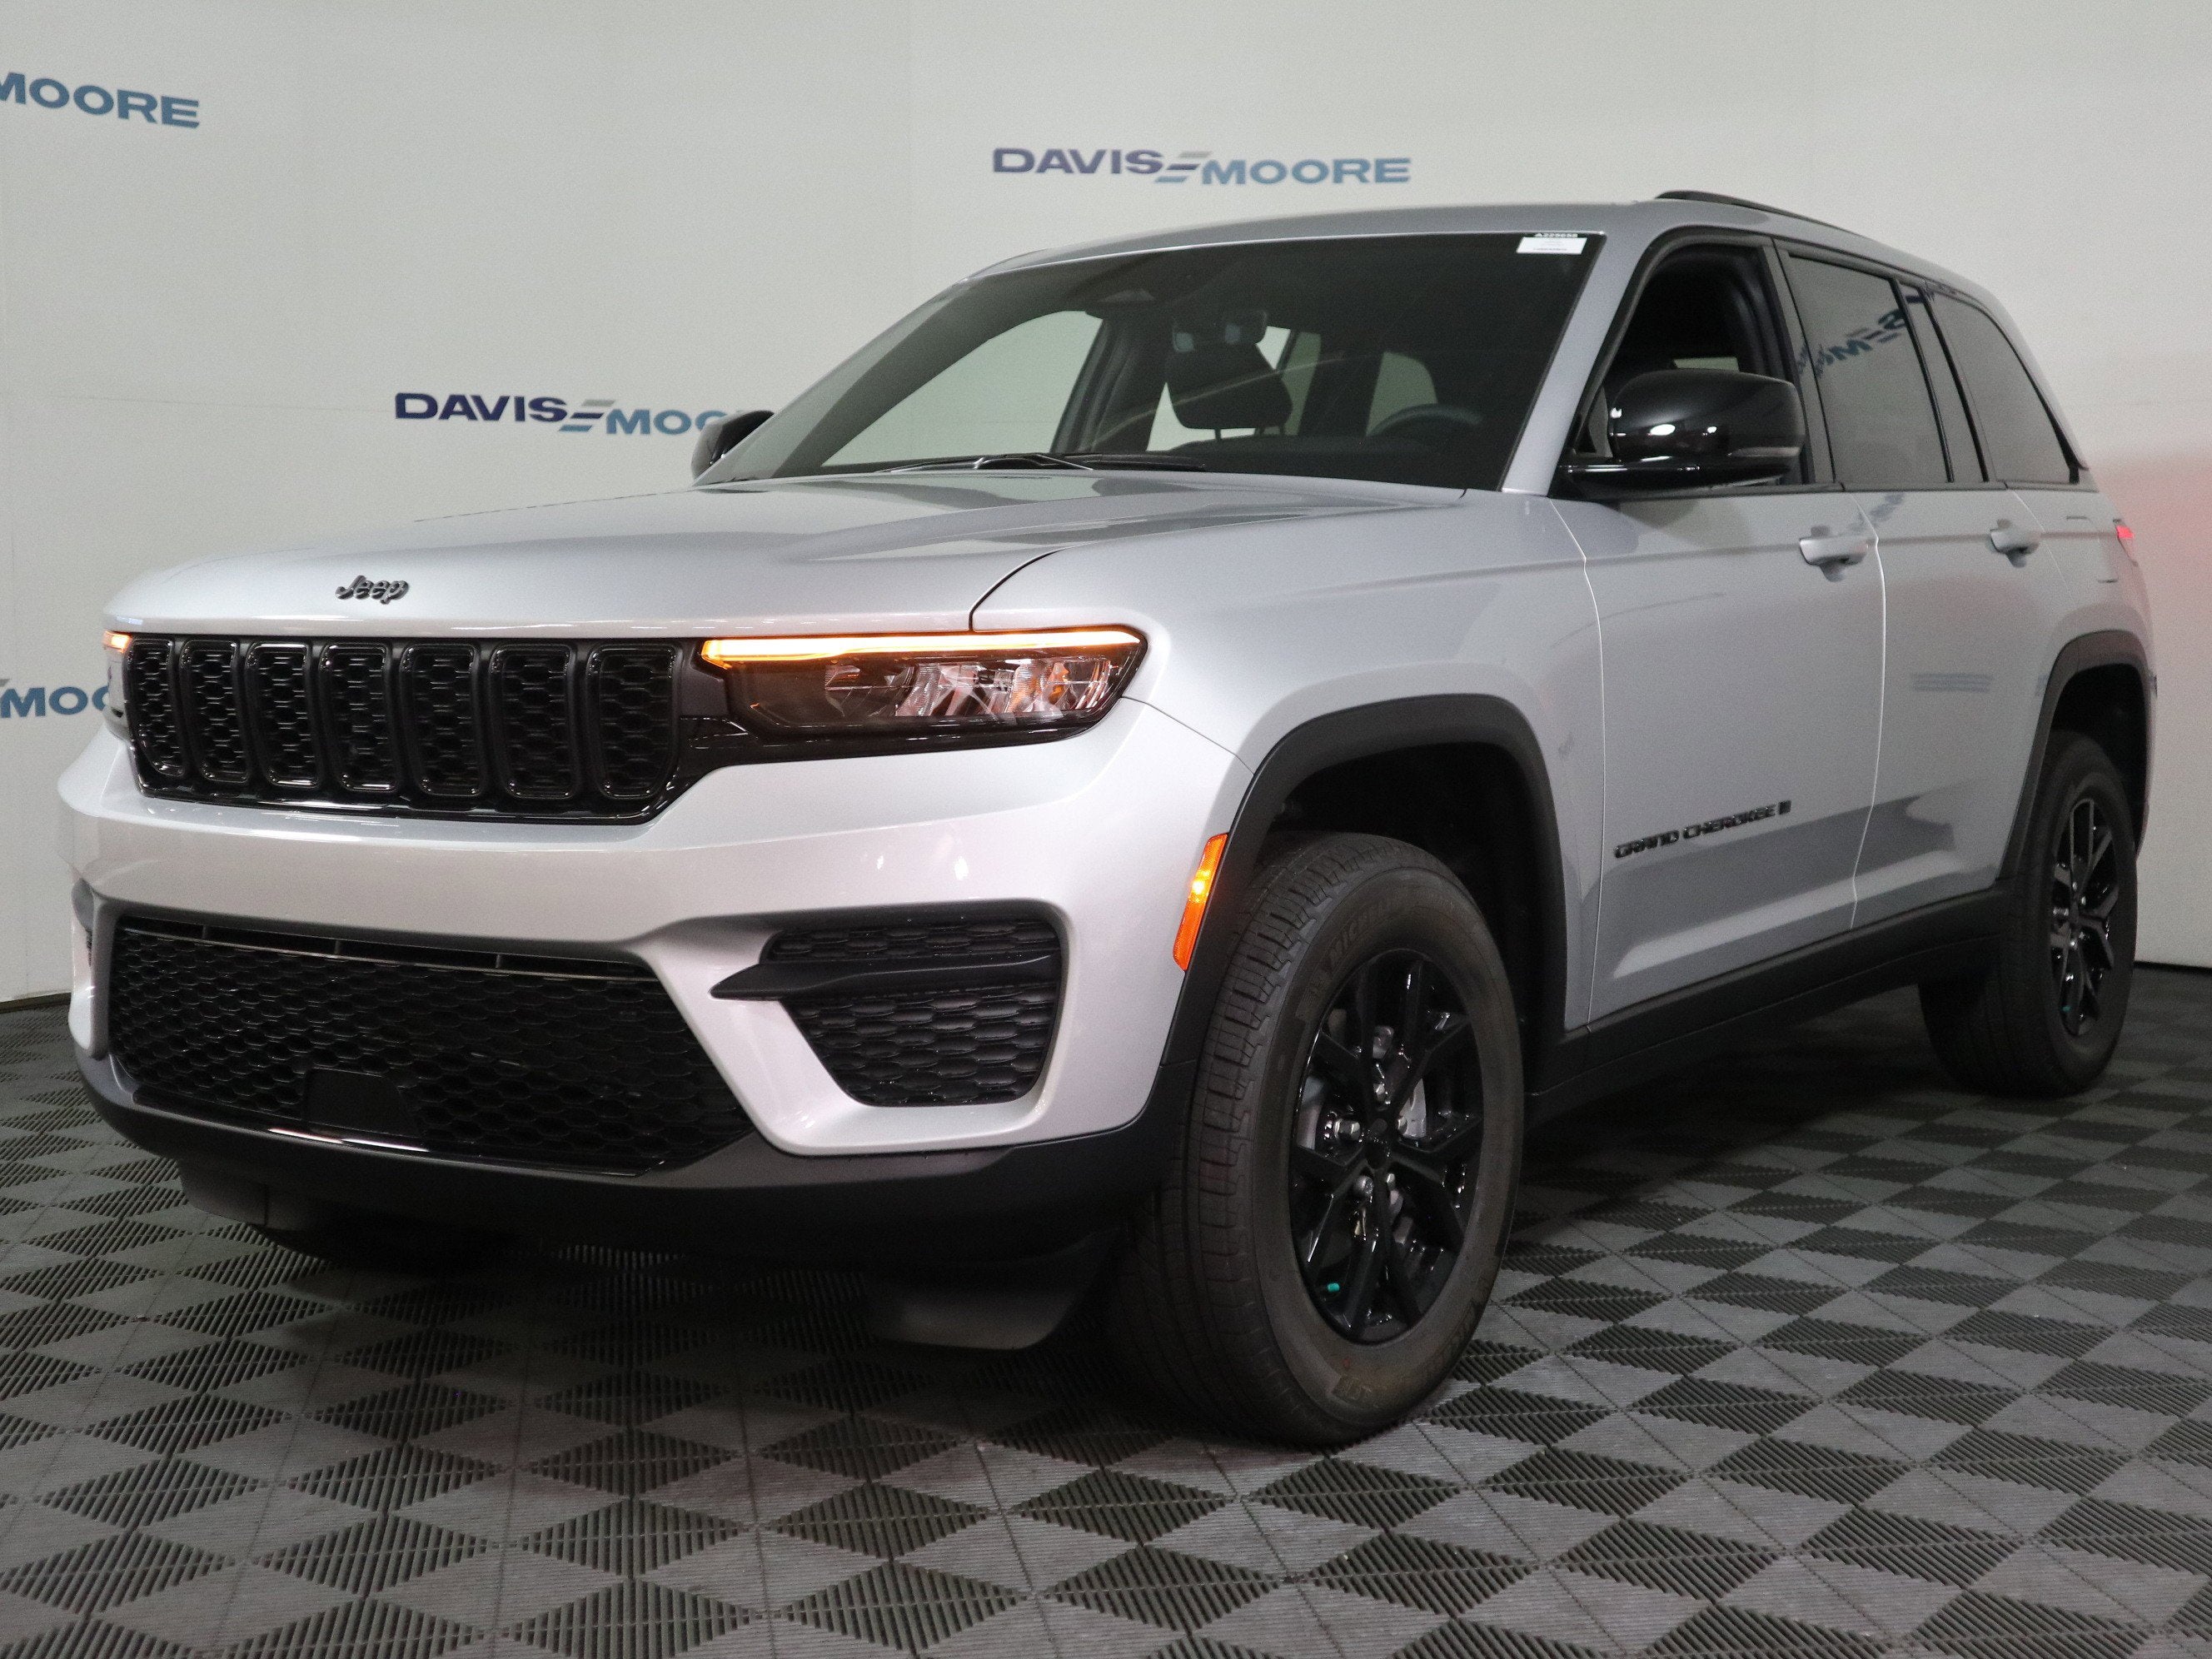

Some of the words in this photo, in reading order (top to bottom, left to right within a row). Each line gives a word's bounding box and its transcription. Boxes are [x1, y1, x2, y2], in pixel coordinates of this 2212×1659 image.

[0, 72, 200, 129] MOORE
[993, 147, 1163, 175] DAVIS
[1202, 157, 1412, 185] MOORE
[395, 392, 567, 422] DAVIS
[335, 575, 410, 605] Jeep
